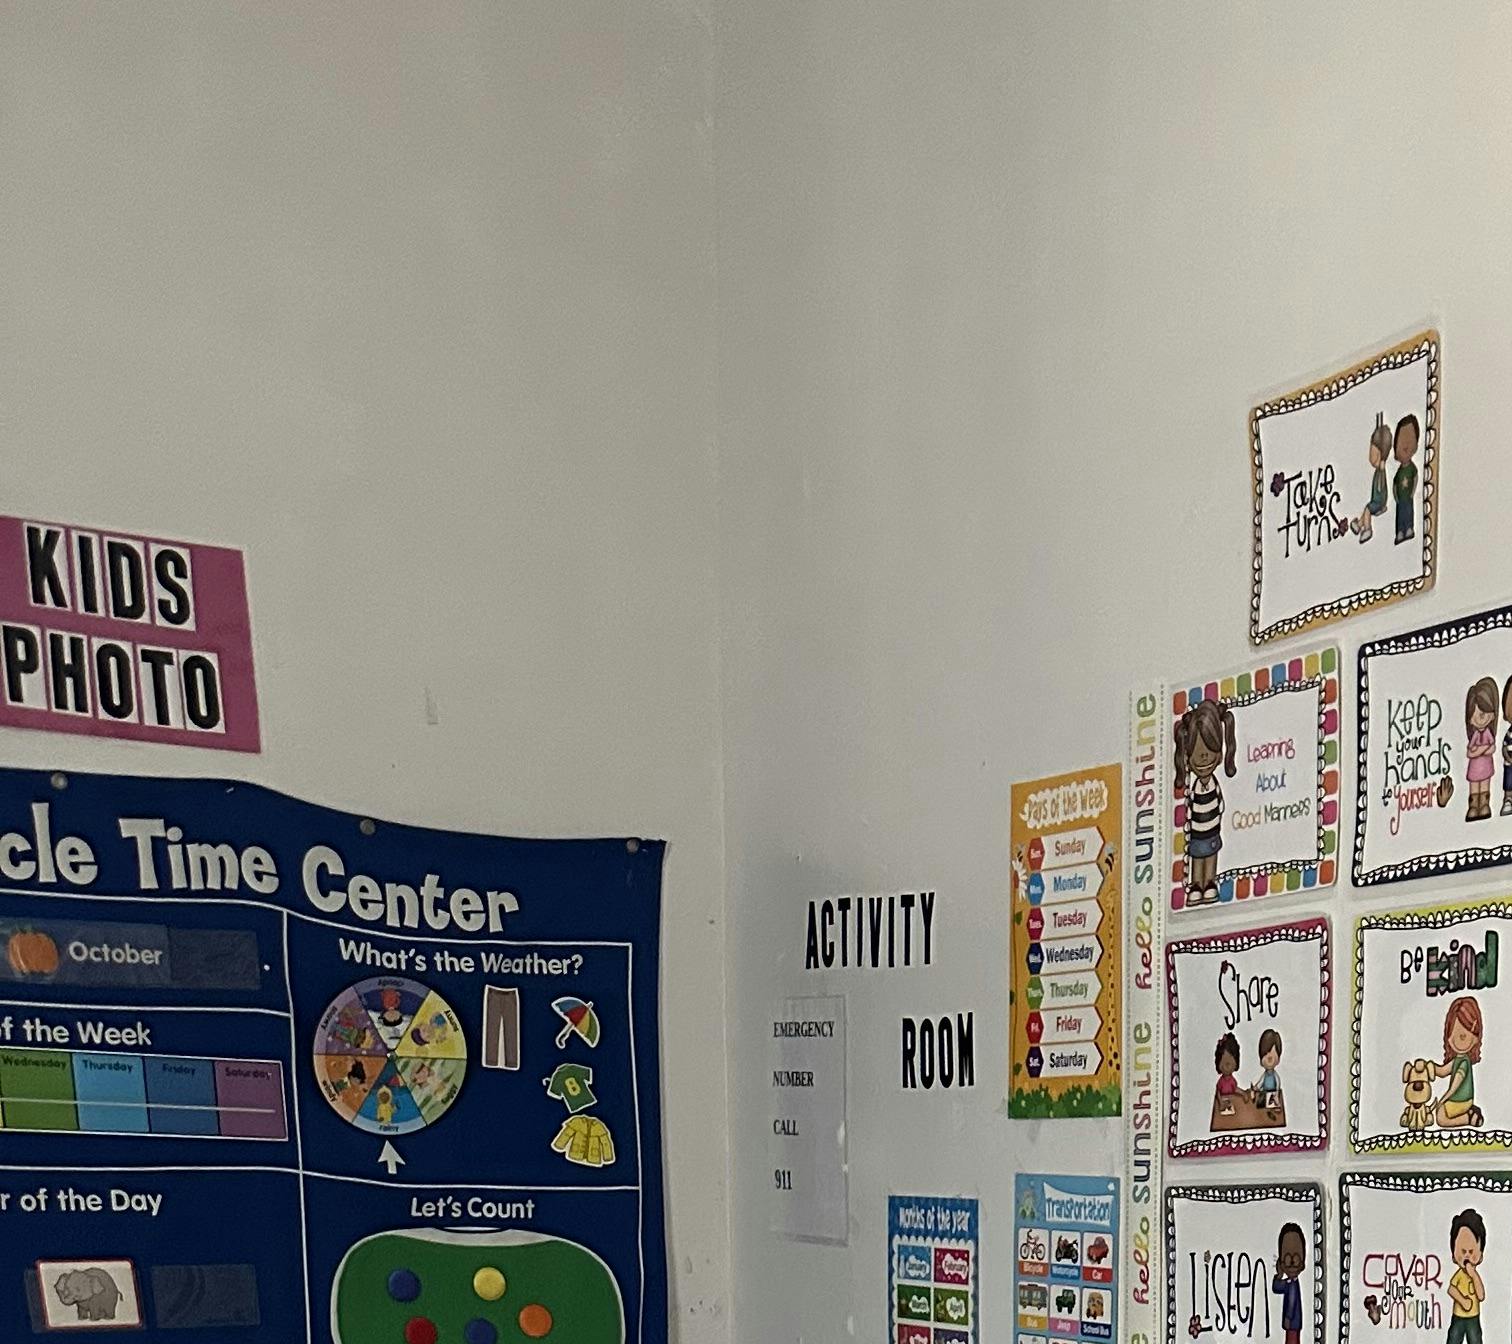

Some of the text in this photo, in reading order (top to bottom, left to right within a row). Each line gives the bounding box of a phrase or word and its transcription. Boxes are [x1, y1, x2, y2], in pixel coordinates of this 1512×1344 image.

[25, 525, 191, 625] KIDS
[2, 623, 221, 730] PHOTO
[1247, 739, 1296, 763] Learning
[1384, 738, 1451, 787] hands
[1396, 735, 1425, 765] your
[1256, 768, 1287, 793] About
[1232, 797, 1311, 830] Good Manners
[118, 816, 520, 933] Time Center
[1053, 873, 1087, 892] Monday
[805, 892, 935, 970] ACTIVITY
[1052, 910, 1088, 928] Tuesday
[69, 941, 163, 965] October
[339, 938, 583, 975] What's the Weather?
[1046, 944, 1094, 963] Wednesday
[1049, 980, 1088, 998] Thursday
[1218, 961, 1279, 1031] Share
[23, 1018, 152, 1046] the Week
[773, 1021, 834, 1038] EMERGENCY
[1056, 1017, 1082, 1032] Friday
[902, 1012, 974, 1089] ROOM
[1049, 1052, 1088, 1069] Saturday
[772, 1071, 814, 1087] NUMBER
[773, 1120, 799, 1135] CALL
[774, 1170, 792, 1189] 911
[20, 1188, 163, 1216] of the Day
[410, 1196, 535, 1218] Let's Count
[1389, 1294, 1442, 1329] mouth
